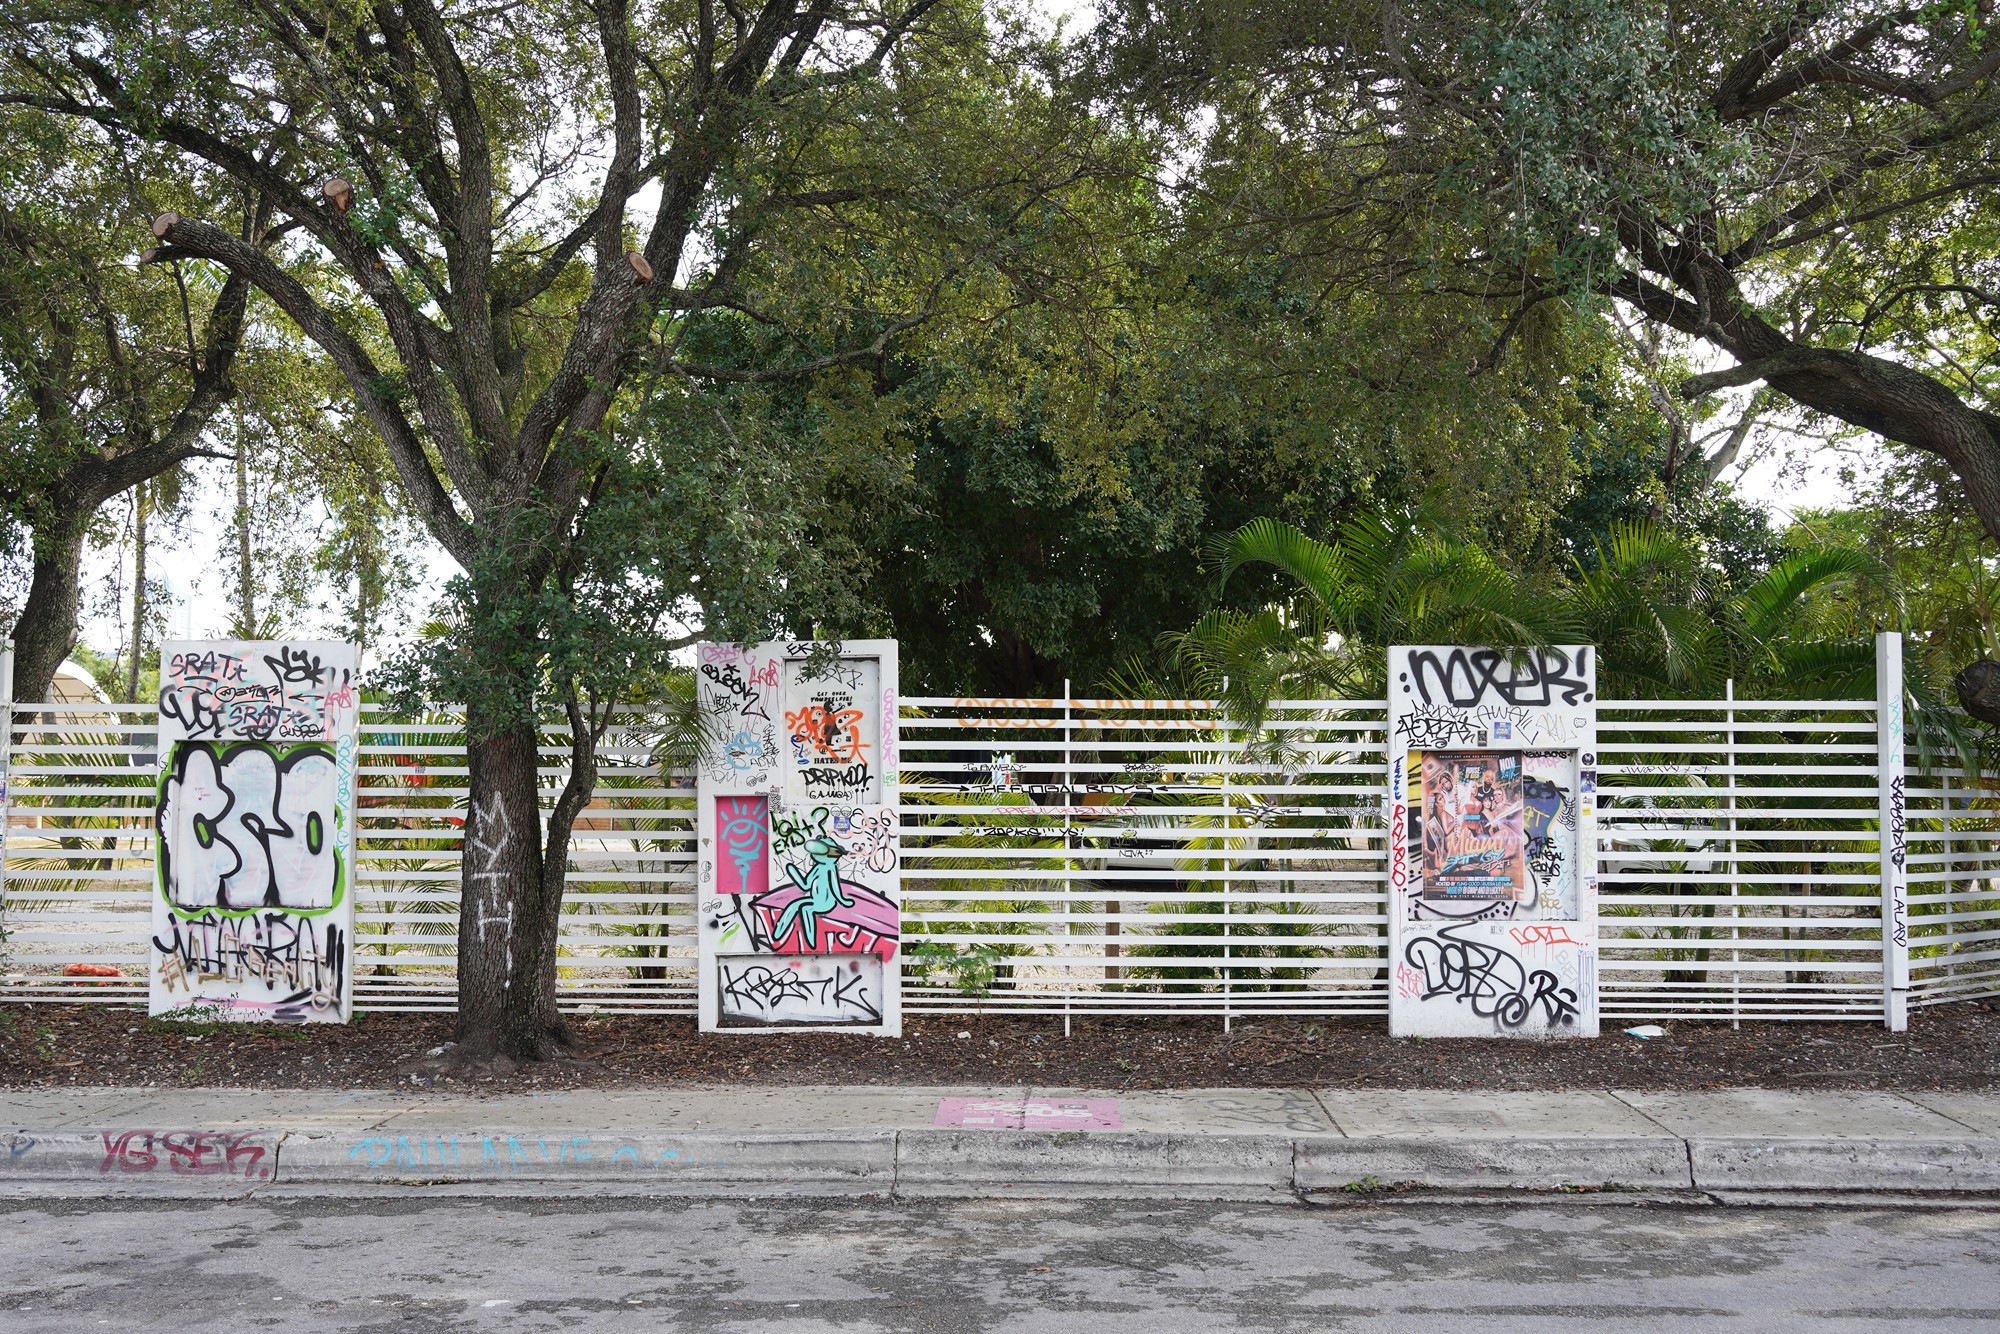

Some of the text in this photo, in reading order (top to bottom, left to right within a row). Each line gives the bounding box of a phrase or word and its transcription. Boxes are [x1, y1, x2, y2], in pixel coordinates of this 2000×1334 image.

[972, 784, 1154, 794] THE FUNGAL BOYS
